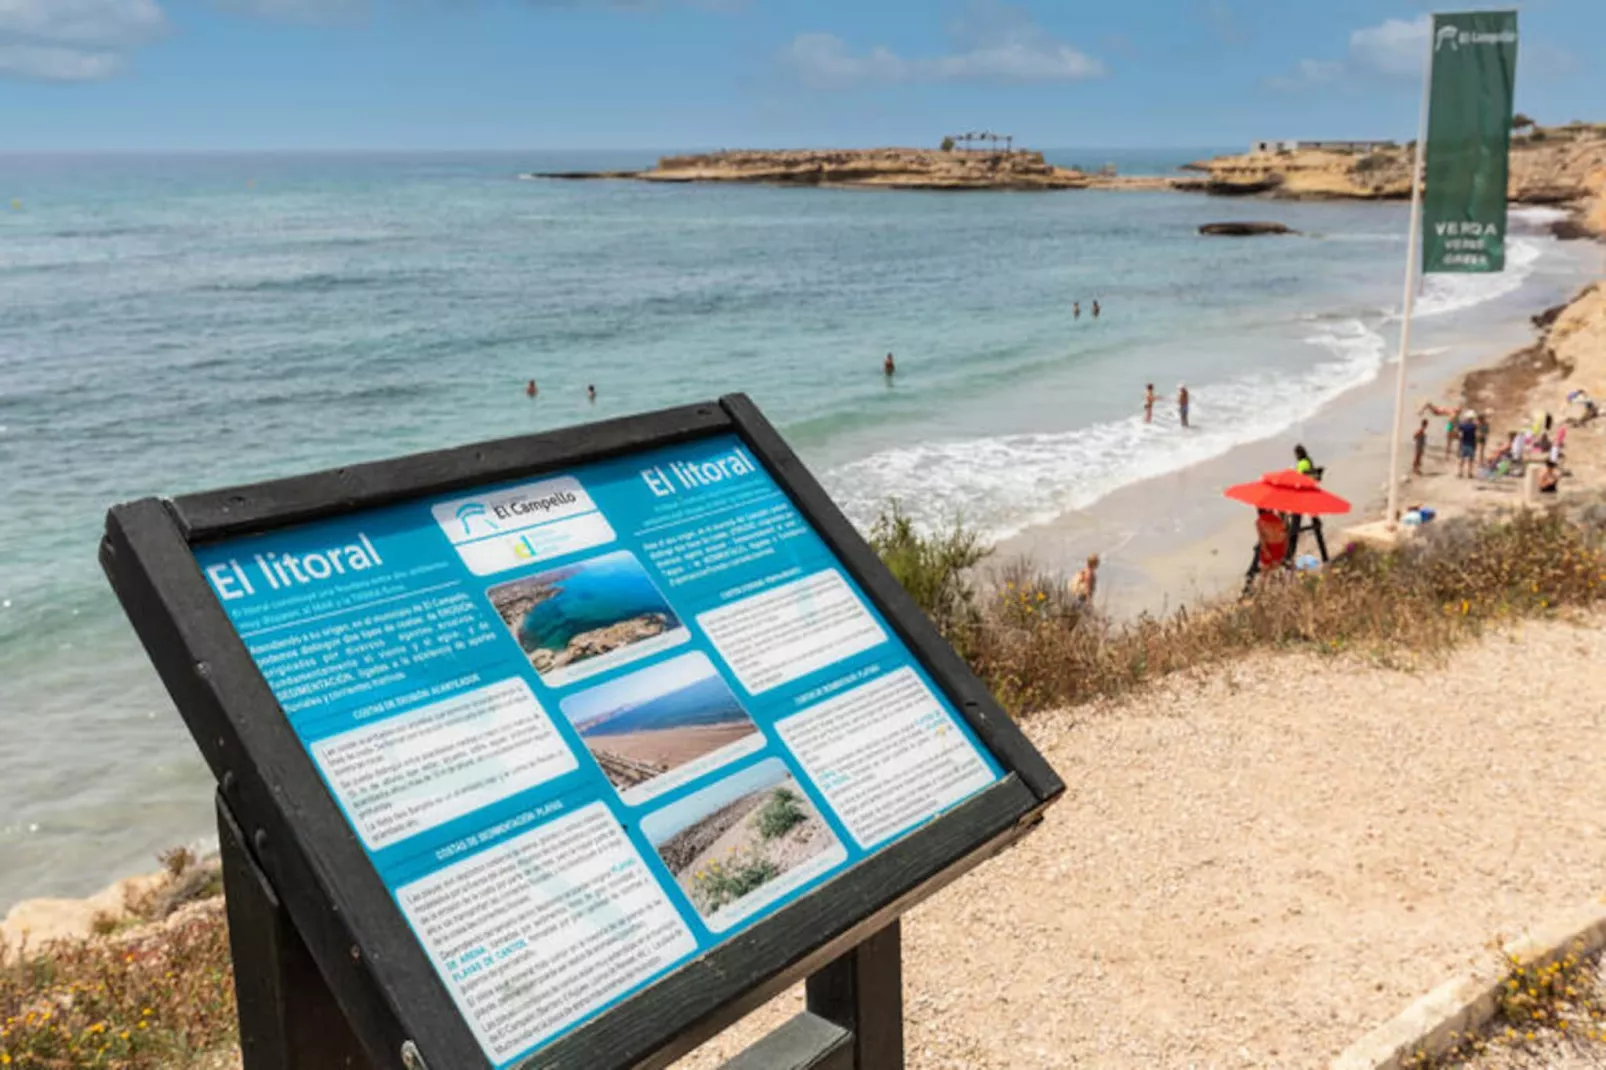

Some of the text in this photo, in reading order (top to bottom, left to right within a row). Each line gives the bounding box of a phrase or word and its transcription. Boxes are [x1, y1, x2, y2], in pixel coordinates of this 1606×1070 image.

[640, 465, 676, 497] El
[669, 446, 756, 490] litoral
[493, 503, 511, 519] El
[510, 492, 577, 515] Campello
[205, 532, 384, 600] El litoral
